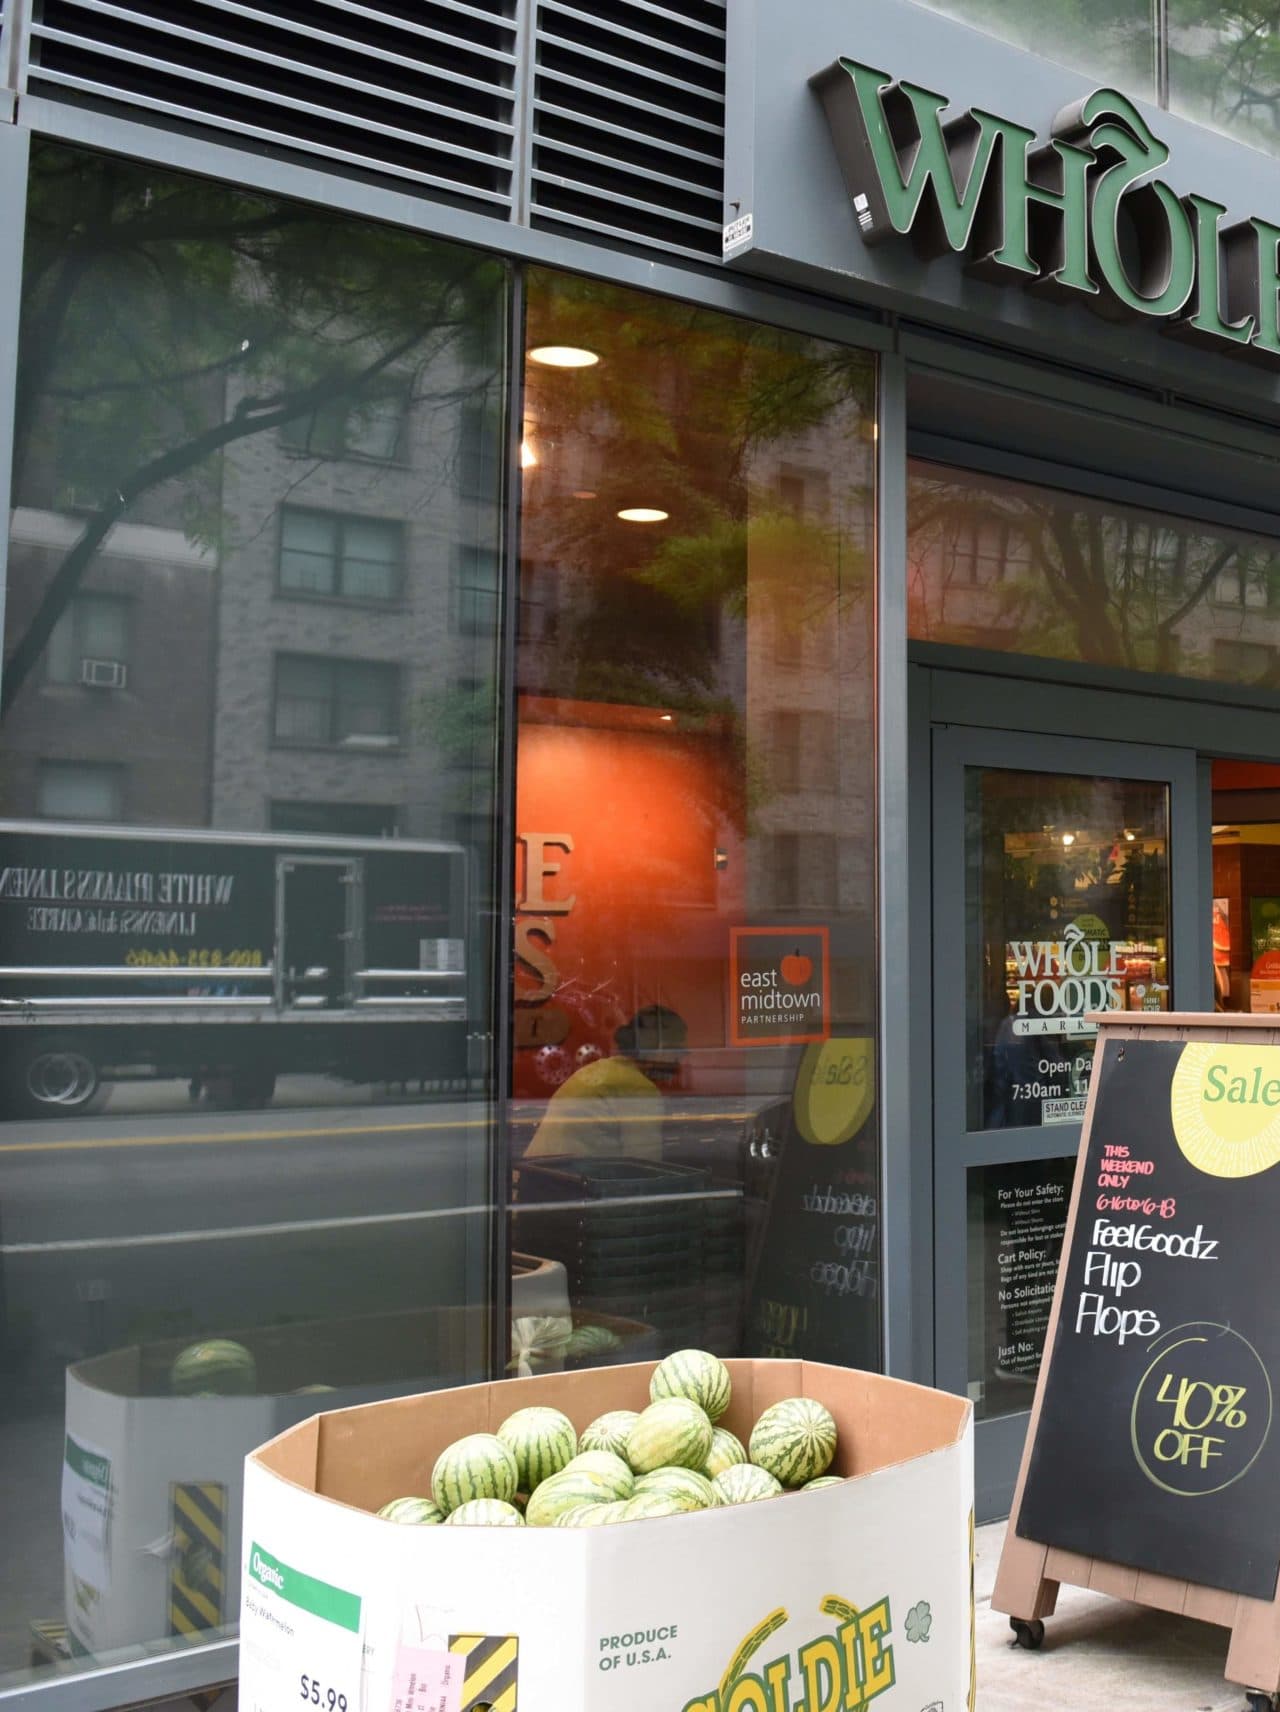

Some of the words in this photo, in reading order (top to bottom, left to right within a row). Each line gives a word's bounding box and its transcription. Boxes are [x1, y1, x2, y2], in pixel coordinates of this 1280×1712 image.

[1010, 934, 1128, 978] WHOLE
[740, 969, 778, 988] east
[741, 988, 821, 1011] midtown
[1016, 977, 1123, 1017] FOODS
[741, 1013, 804, 1024] PARTNERSHIP
[1021, 1019, 1100, 1033] MARK
[1038, 1059, 1071, 1078] Open
[1076, 1057, 1092, 1072] Da
[1012, 1081, 1061, 1100] 7:30am
[1074, 1079, 1089, 1095] 11
[1045, 1102, 1069, 1113] STAND
[1104, 1144, 1130, 1158] THIS
[1100, 1158, 1154, 1175] WEEKEND
[998, 1189, 1012, 1200] For
[1014, 1187, 1034, 1199] Your
[1036, 1183, 1064, 1197] Safety:
[1097, 1173, 1130, 1189] ONLY
[998, 1252, 1016, 1265] Cart
[1018, 1248, 1047, 1261] Policy:
[1084, 1251, 1142, 1297] Flip
[998, 1289, 1012, 1302] No
[1013, 1282, 1056, 1299] Solicitatio
[1075, 1291, 1161, 1346] Flops
[997, 1344, 1016, 1360] Just
[1018, 1341, 1035, 1353] No:
[1156, 1373, 1248, 1430] 40%
[1153, 1428, 1226, 1469] OFF
[252, 1551, 285, 1590] Organic
[599, 1624, 679, 1652] PRODUCE
[599, 1654, 622, 1672] OF
[625, 1648, 672, 1667] U.S.A.
[681, 1595, 896, 1712] LDIE
[300, 1673, 348, 1712] $5.99
